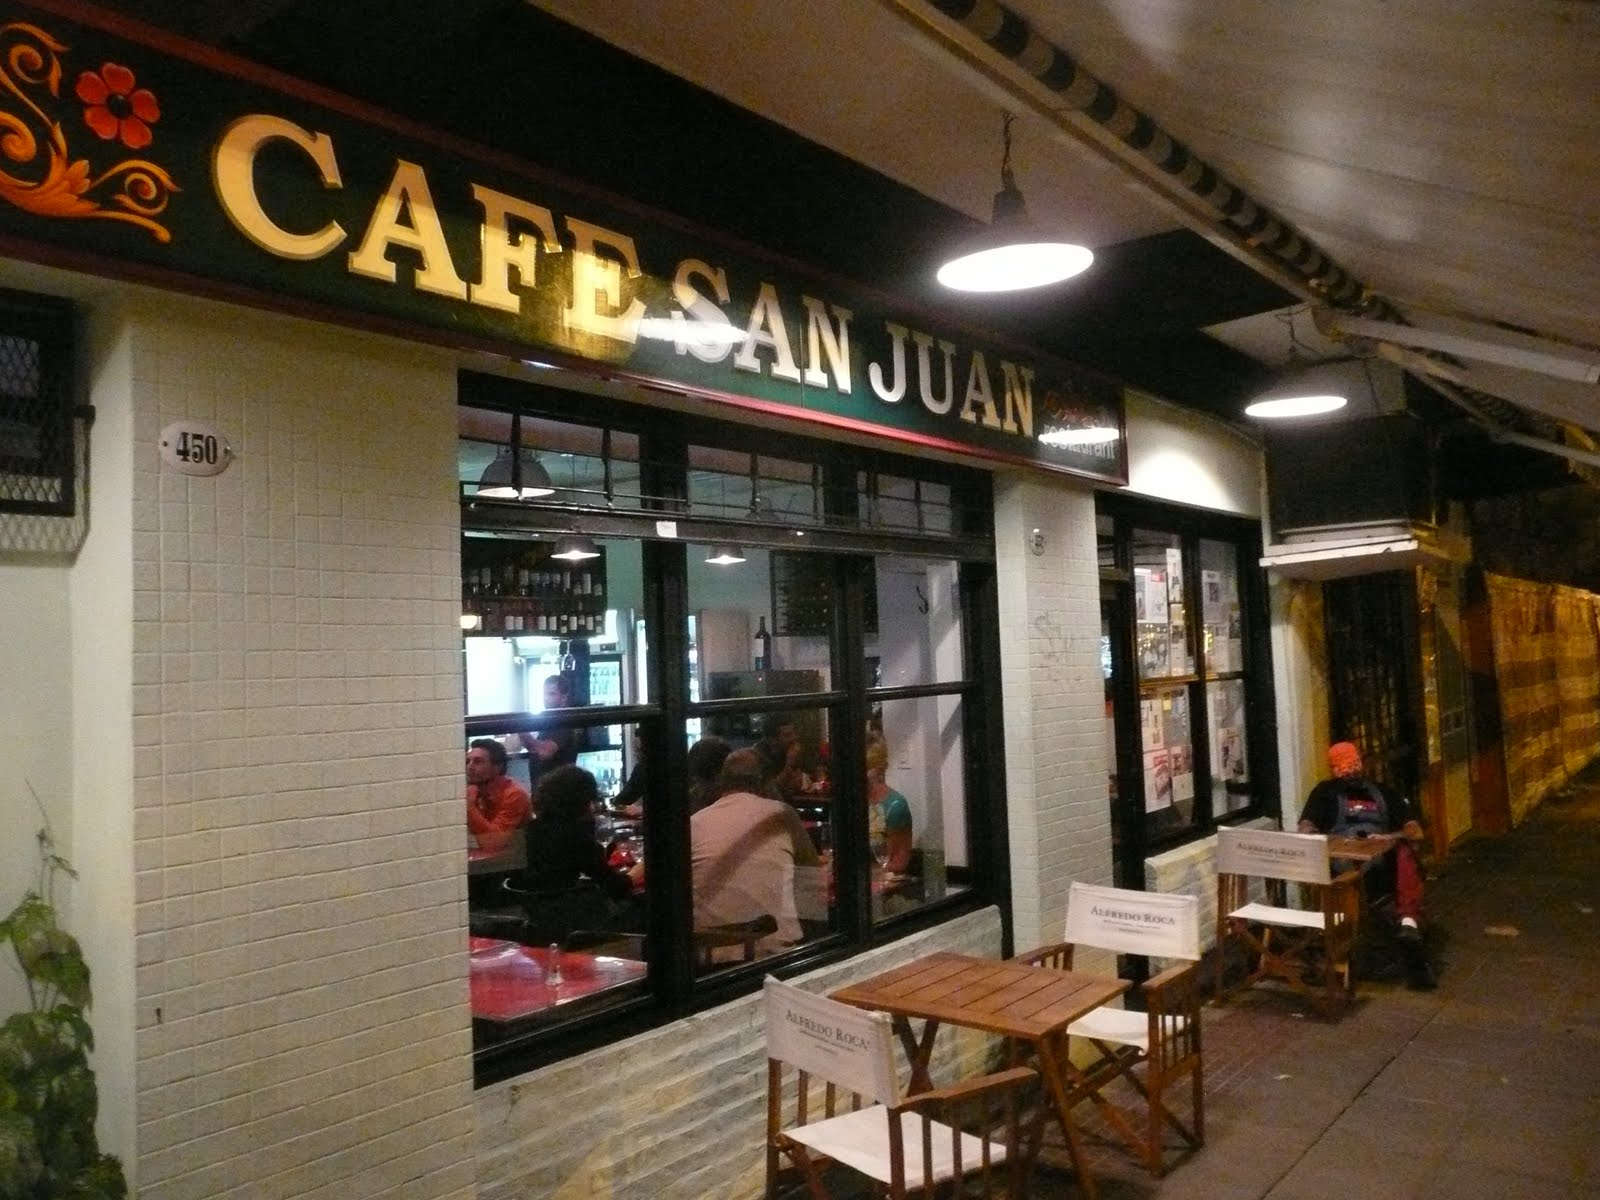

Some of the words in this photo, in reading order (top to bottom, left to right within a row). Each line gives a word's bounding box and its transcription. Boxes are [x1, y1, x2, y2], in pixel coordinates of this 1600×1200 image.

[210, 113, 647, 344] CAFE
[672, 258, 853, 395] SAN
[867, 320, 1035, 439] JUAN
[176, 431, 218, 465] 450
[1090, 904, 1141, 922] ALFREDO
[1144, 913, 1176, 926] ROCA
[785, 1009, 833, 1038] ALFREDO
[835, 1027, 869, 1050] ROCA
